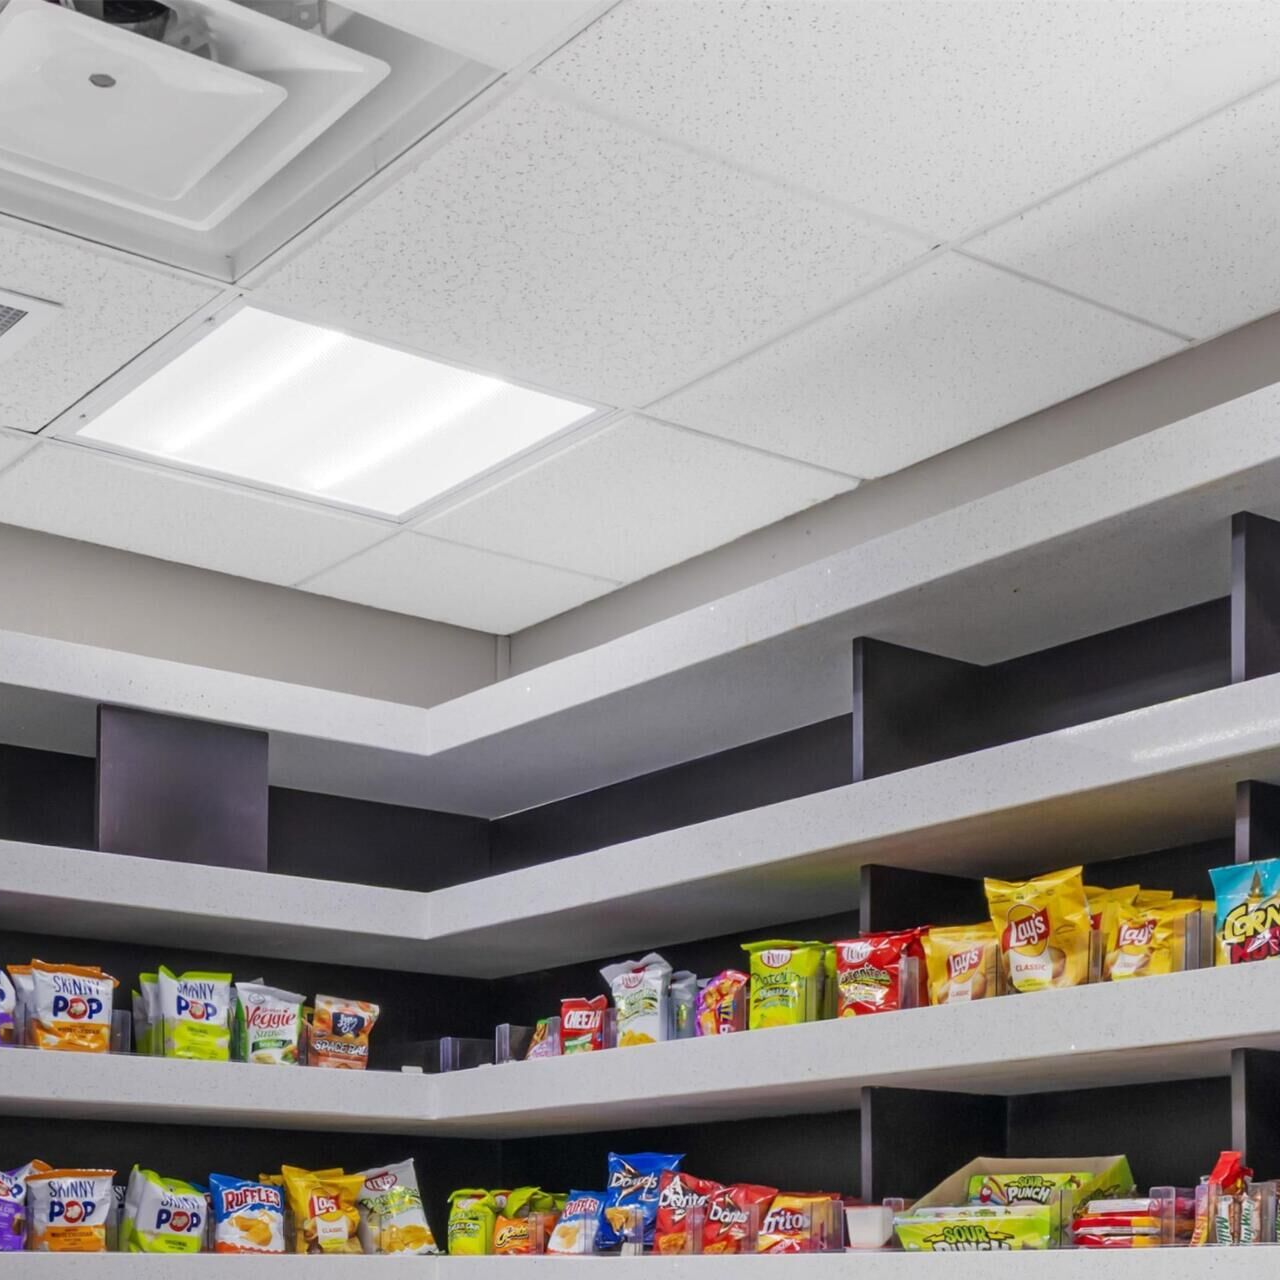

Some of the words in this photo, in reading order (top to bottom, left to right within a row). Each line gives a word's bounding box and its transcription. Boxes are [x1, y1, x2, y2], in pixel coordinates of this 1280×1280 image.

[1009, 914, 1046, 949] Lay's
[949, 949, 980, 977] Lay's
[1016, 964, 1046, 972] CLASSIC
[53, 975, 101, 995] SKINNY
[52, 996, 103, 1019] POP
[176, 996, 217, 1021] POP
[244, 1006, 297, 1029] Veggie
[48, 1180, 96, 1199] SKINNY
[1017, 1176, 1043, 1187] SOUR
[223, 1188, 280, 1213] RUFFLES
[1006, 1186, 1051, 1202] PUNCH
[49, 1201, 96, 1224] POP
[156, 1208, 202, 1233] POP
[943, 1225, 988, 1243] SOUR
